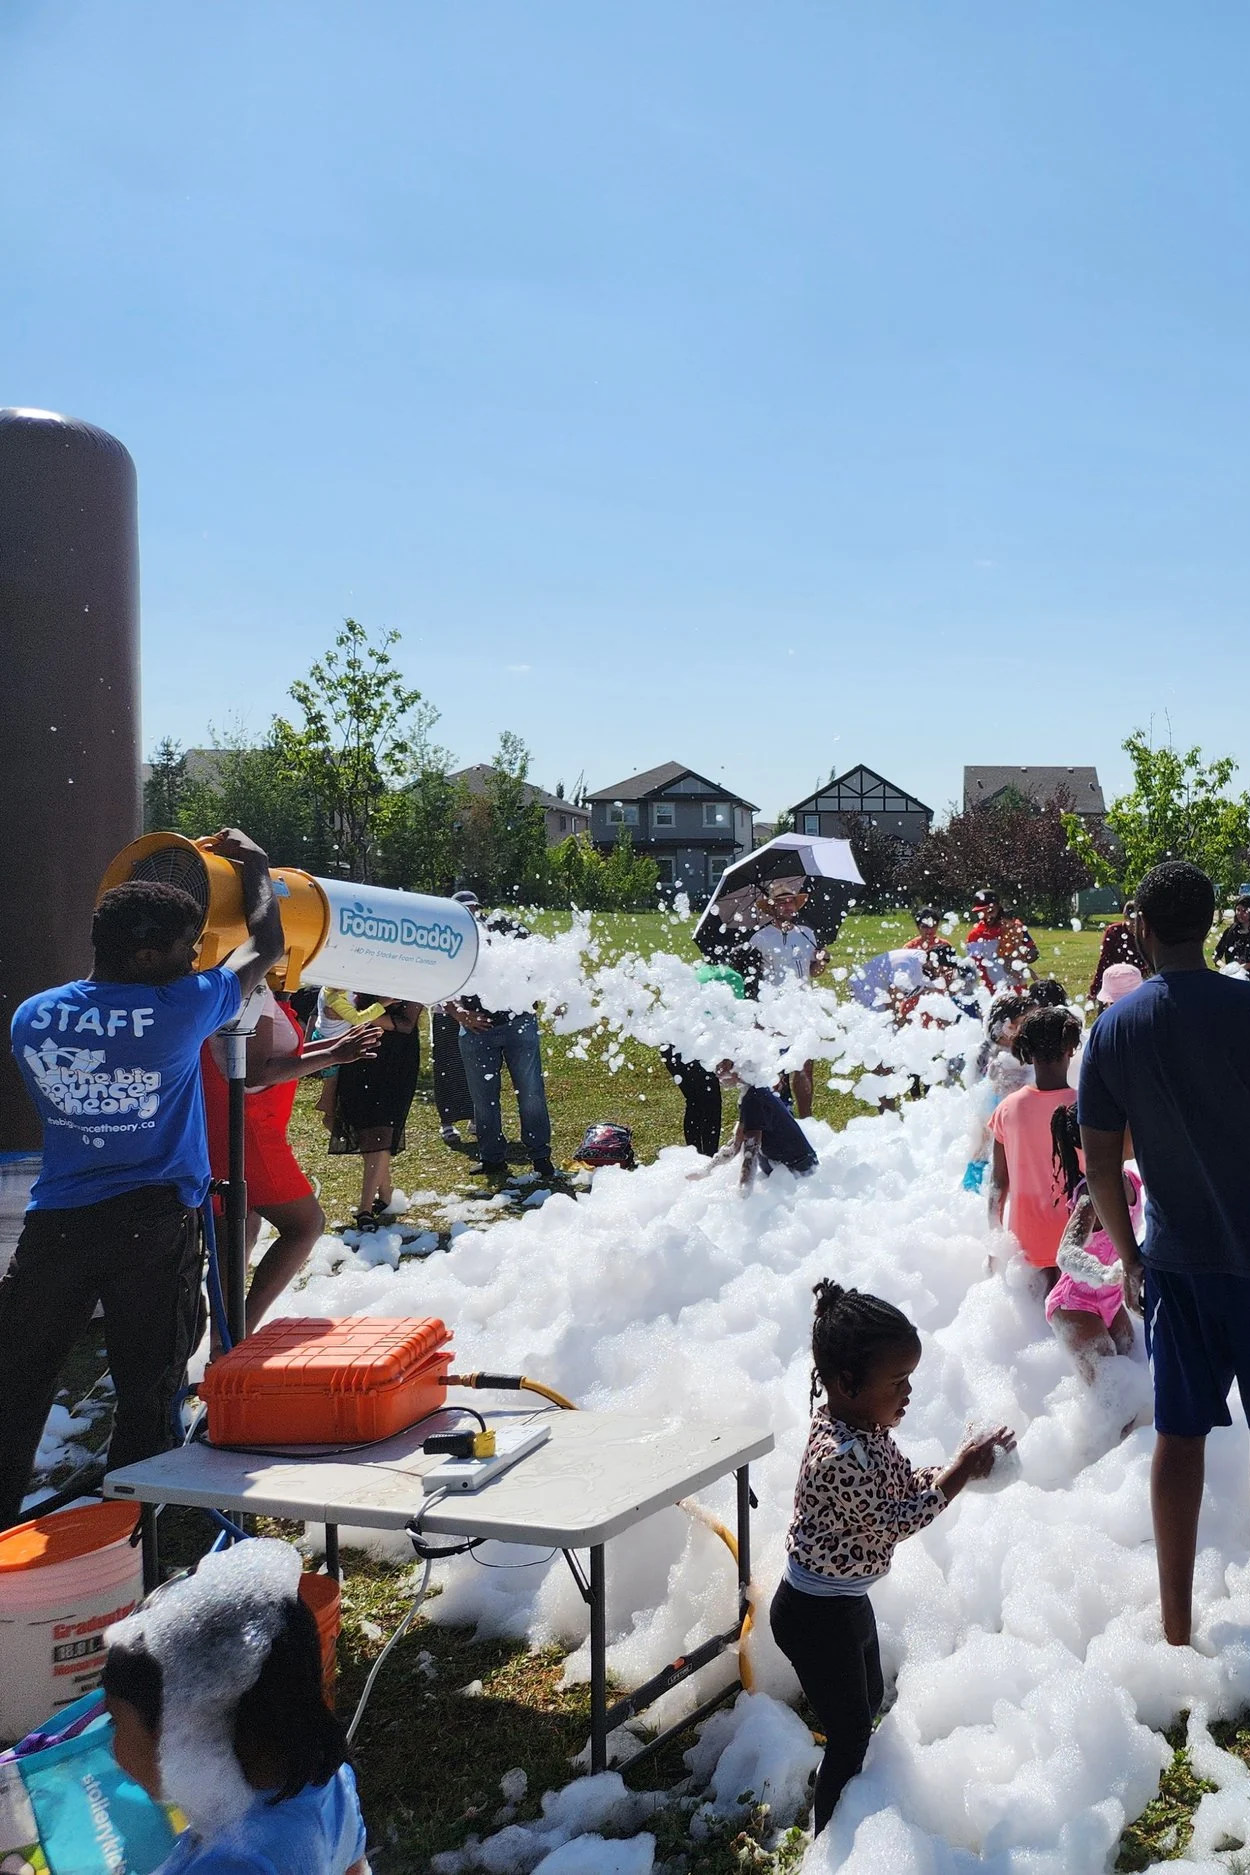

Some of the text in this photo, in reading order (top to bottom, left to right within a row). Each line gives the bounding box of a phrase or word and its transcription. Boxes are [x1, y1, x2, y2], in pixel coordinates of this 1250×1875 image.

[340, 906, 463, 959] Foam Daddy
[31, 1001, 155, 1037] STAFF
[60, 1066, 162, 1091] the big
